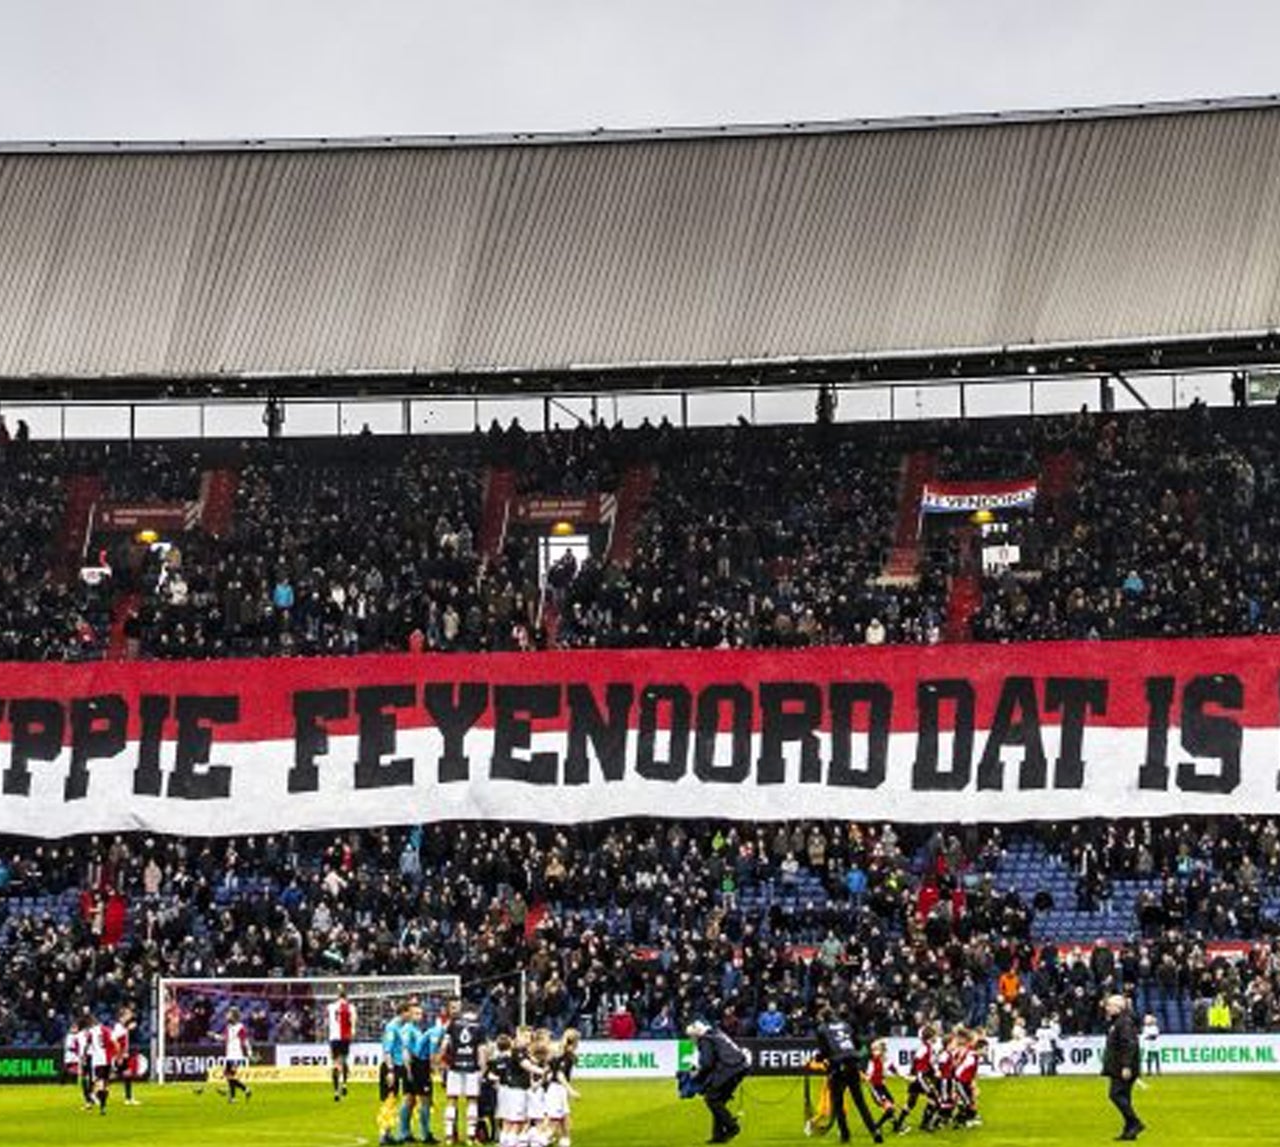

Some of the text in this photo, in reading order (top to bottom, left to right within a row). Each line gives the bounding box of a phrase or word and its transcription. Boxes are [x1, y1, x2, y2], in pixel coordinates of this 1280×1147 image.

[287, 681, 893, 792] FEYENOORD
[912, 676, 1109, 792] DAT
[1139, 673, 1243, 794] IS
[1071, 1048, 1093, 1064] OP
